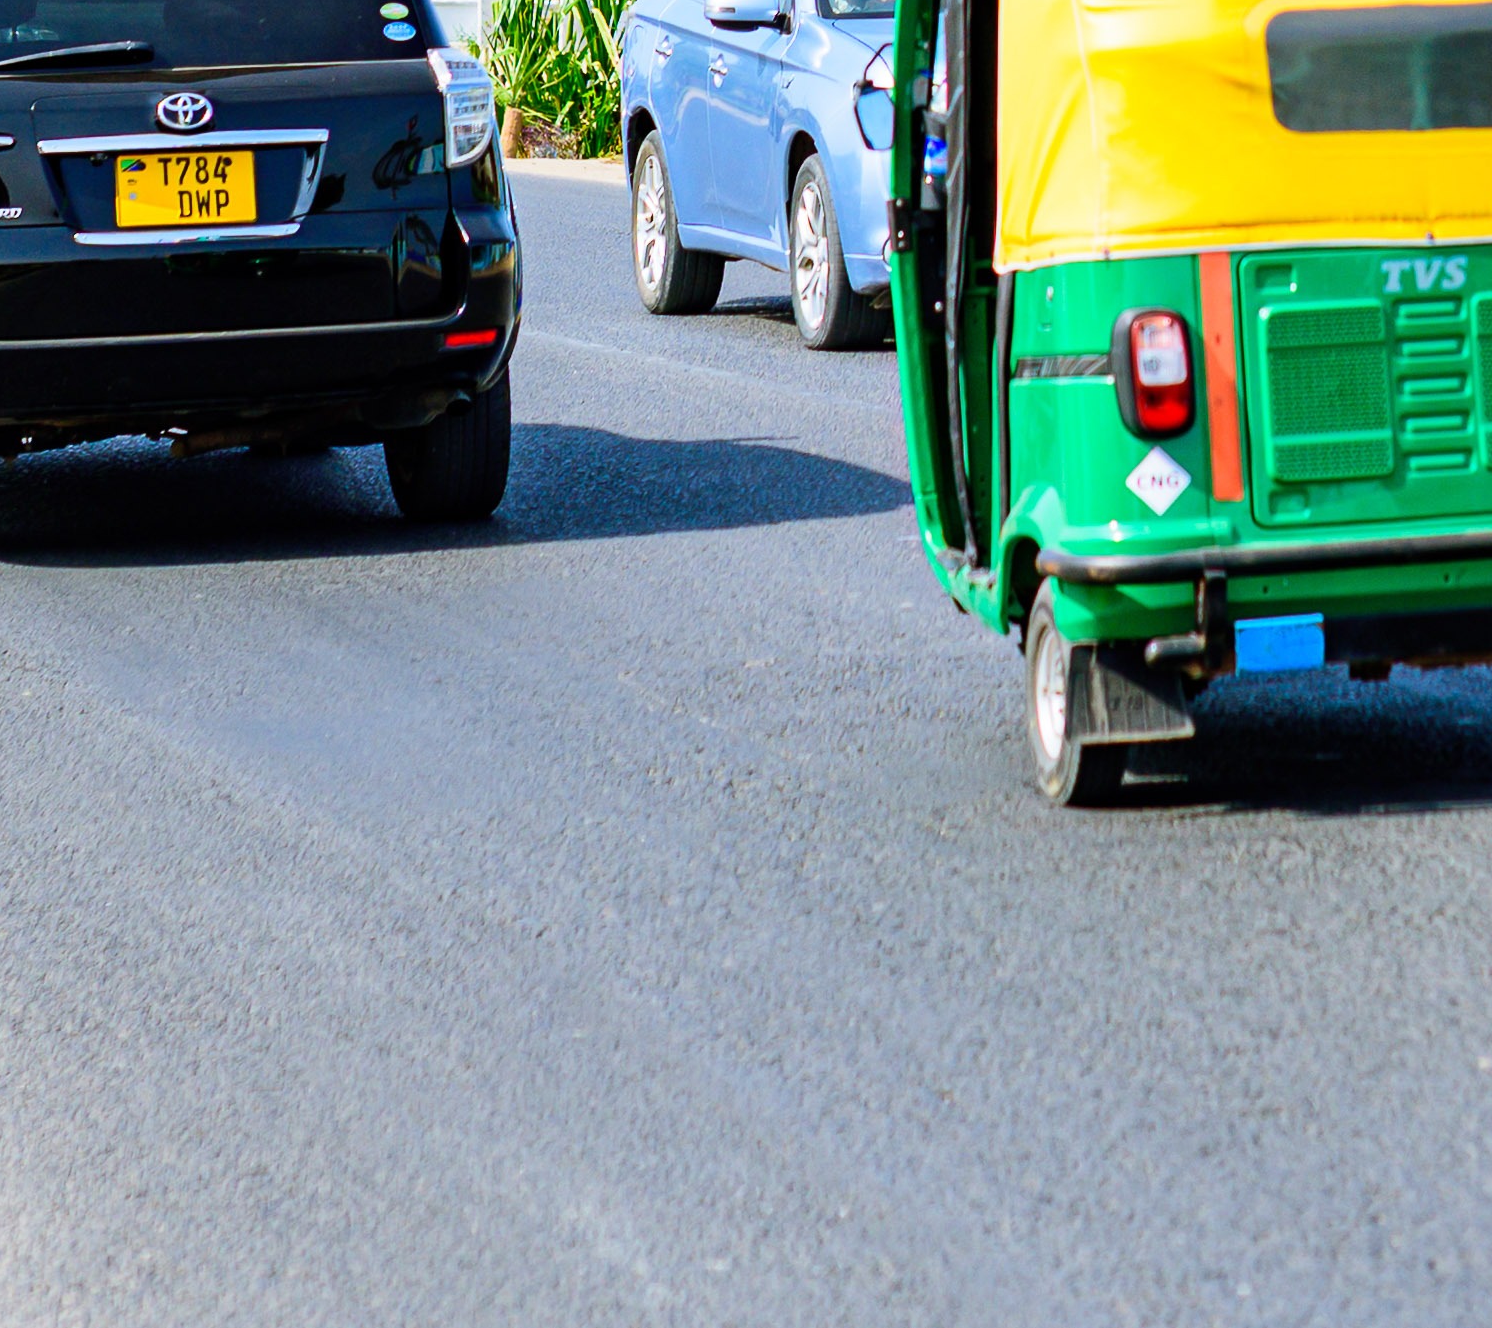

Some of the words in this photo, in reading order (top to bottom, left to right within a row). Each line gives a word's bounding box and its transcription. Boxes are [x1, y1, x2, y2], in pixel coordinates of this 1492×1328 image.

[158, 156, 232, 186] T784
[178, 189, 230, 218] DWP
[1381, 255, 1469, 293] TVS
[1136, 473, 1180, 490] CNG
